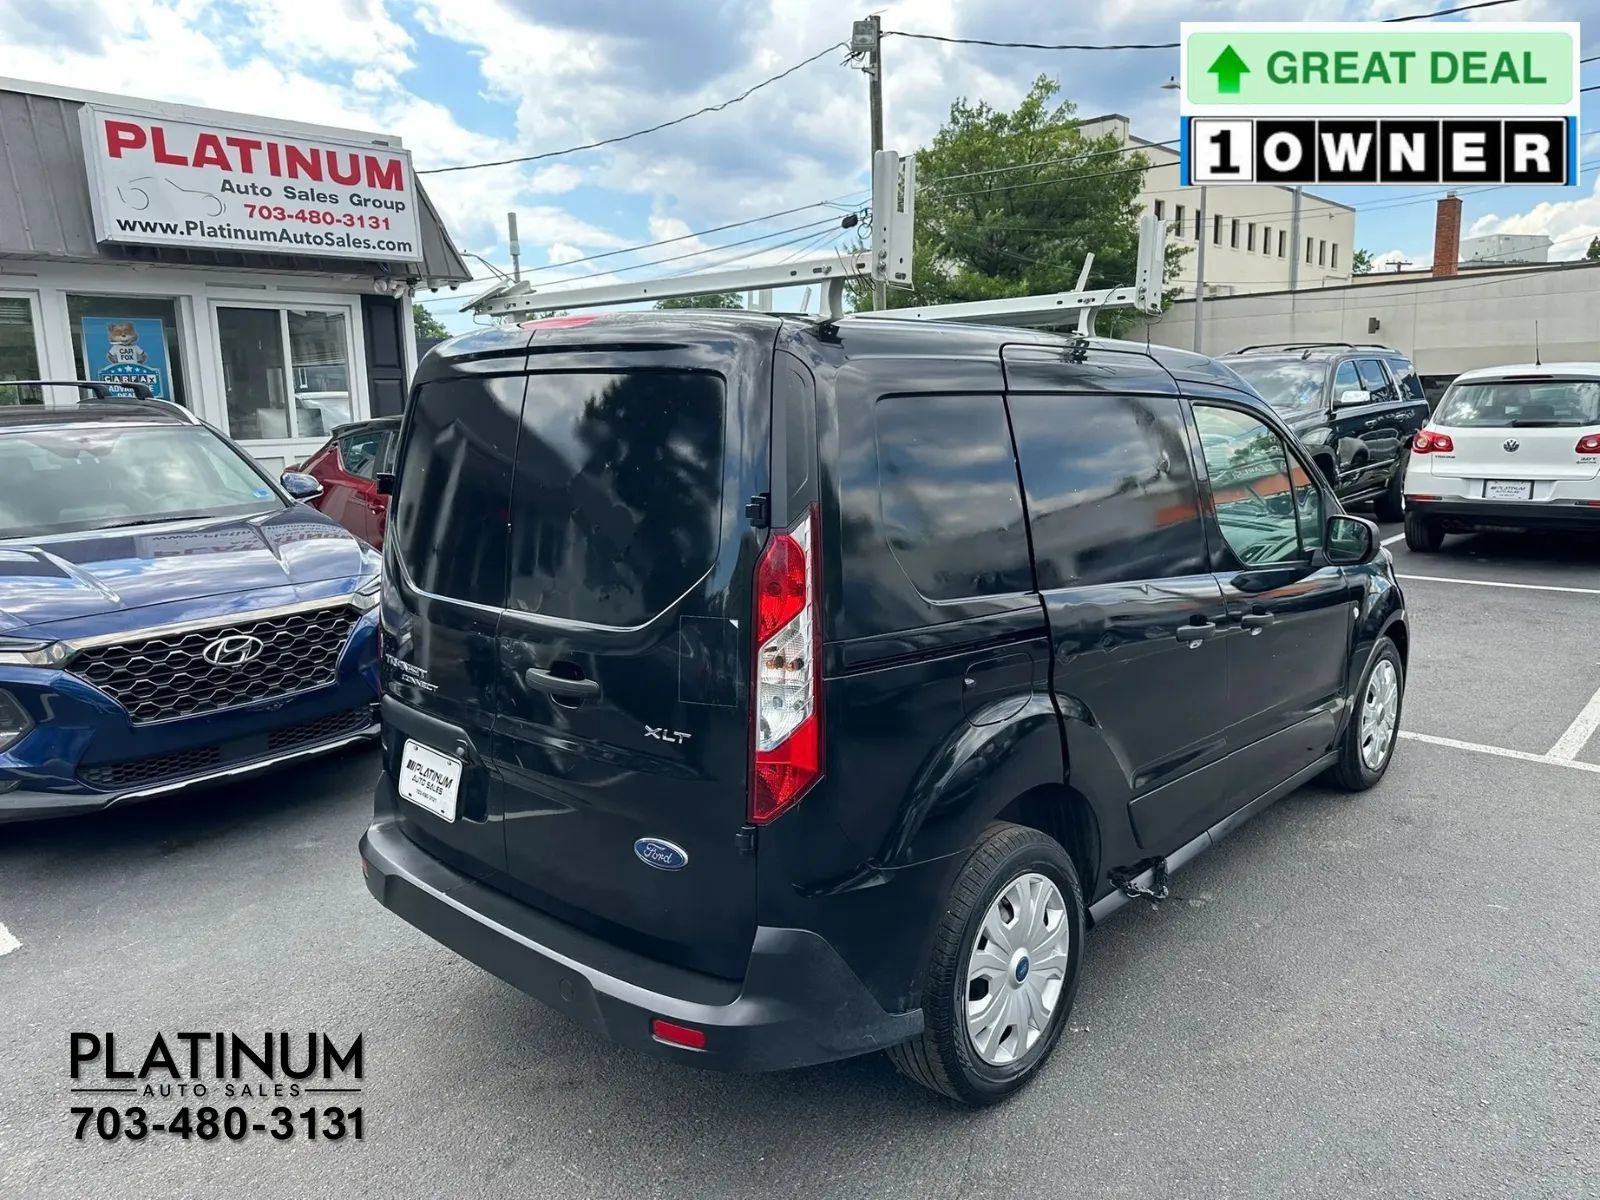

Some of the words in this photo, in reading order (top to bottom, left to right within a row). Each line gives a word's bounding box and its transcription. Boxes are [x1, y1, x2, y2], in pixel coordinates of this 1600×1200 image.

[104, 120, 404, 191] PLATINUM
[220, 179, 272, 198] Auto
[283, 186, 339, 204] Sales
[349, 193, 406, 212] Group
[244, 203, 391, 230] 703-480-3131
[116, 218, 413, 252] www.PlatinumAutoSales.com
[104, 375, 155, 383] CARFAX
[644, 724, 692, 744] XLT
[411, 774, 426, 787] AUTO
[426, 781, 443, 796] SALES
[415, 762, 453, 789] PLATINUM
[643, 842, 673, 864] Ford
